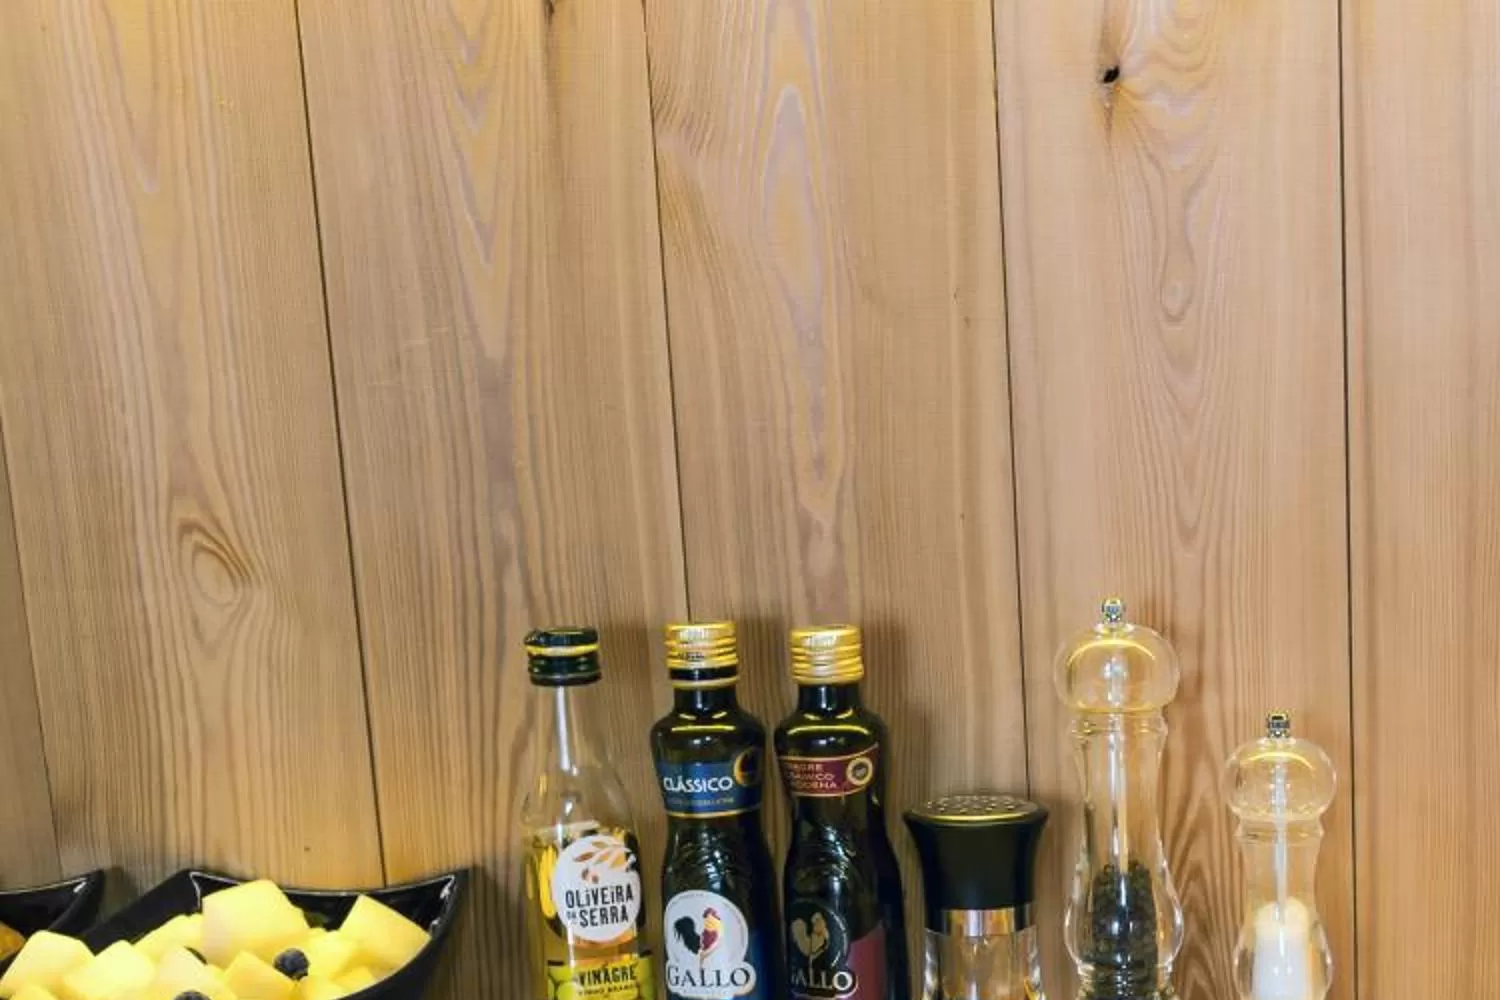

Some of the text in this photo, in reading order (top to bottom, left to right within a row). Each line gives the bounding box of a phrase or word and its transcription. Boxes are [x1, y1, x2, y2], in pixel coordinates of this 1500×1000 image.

[663, 776, 733, 793] CLÁSSICO
[565, 884, 634, 909] OLiVEiRA
[579, 904, 629, 928] SERRA
[577, 965, 637, 988] VINAGRE
[667, 965, 751, 988] GALLO
